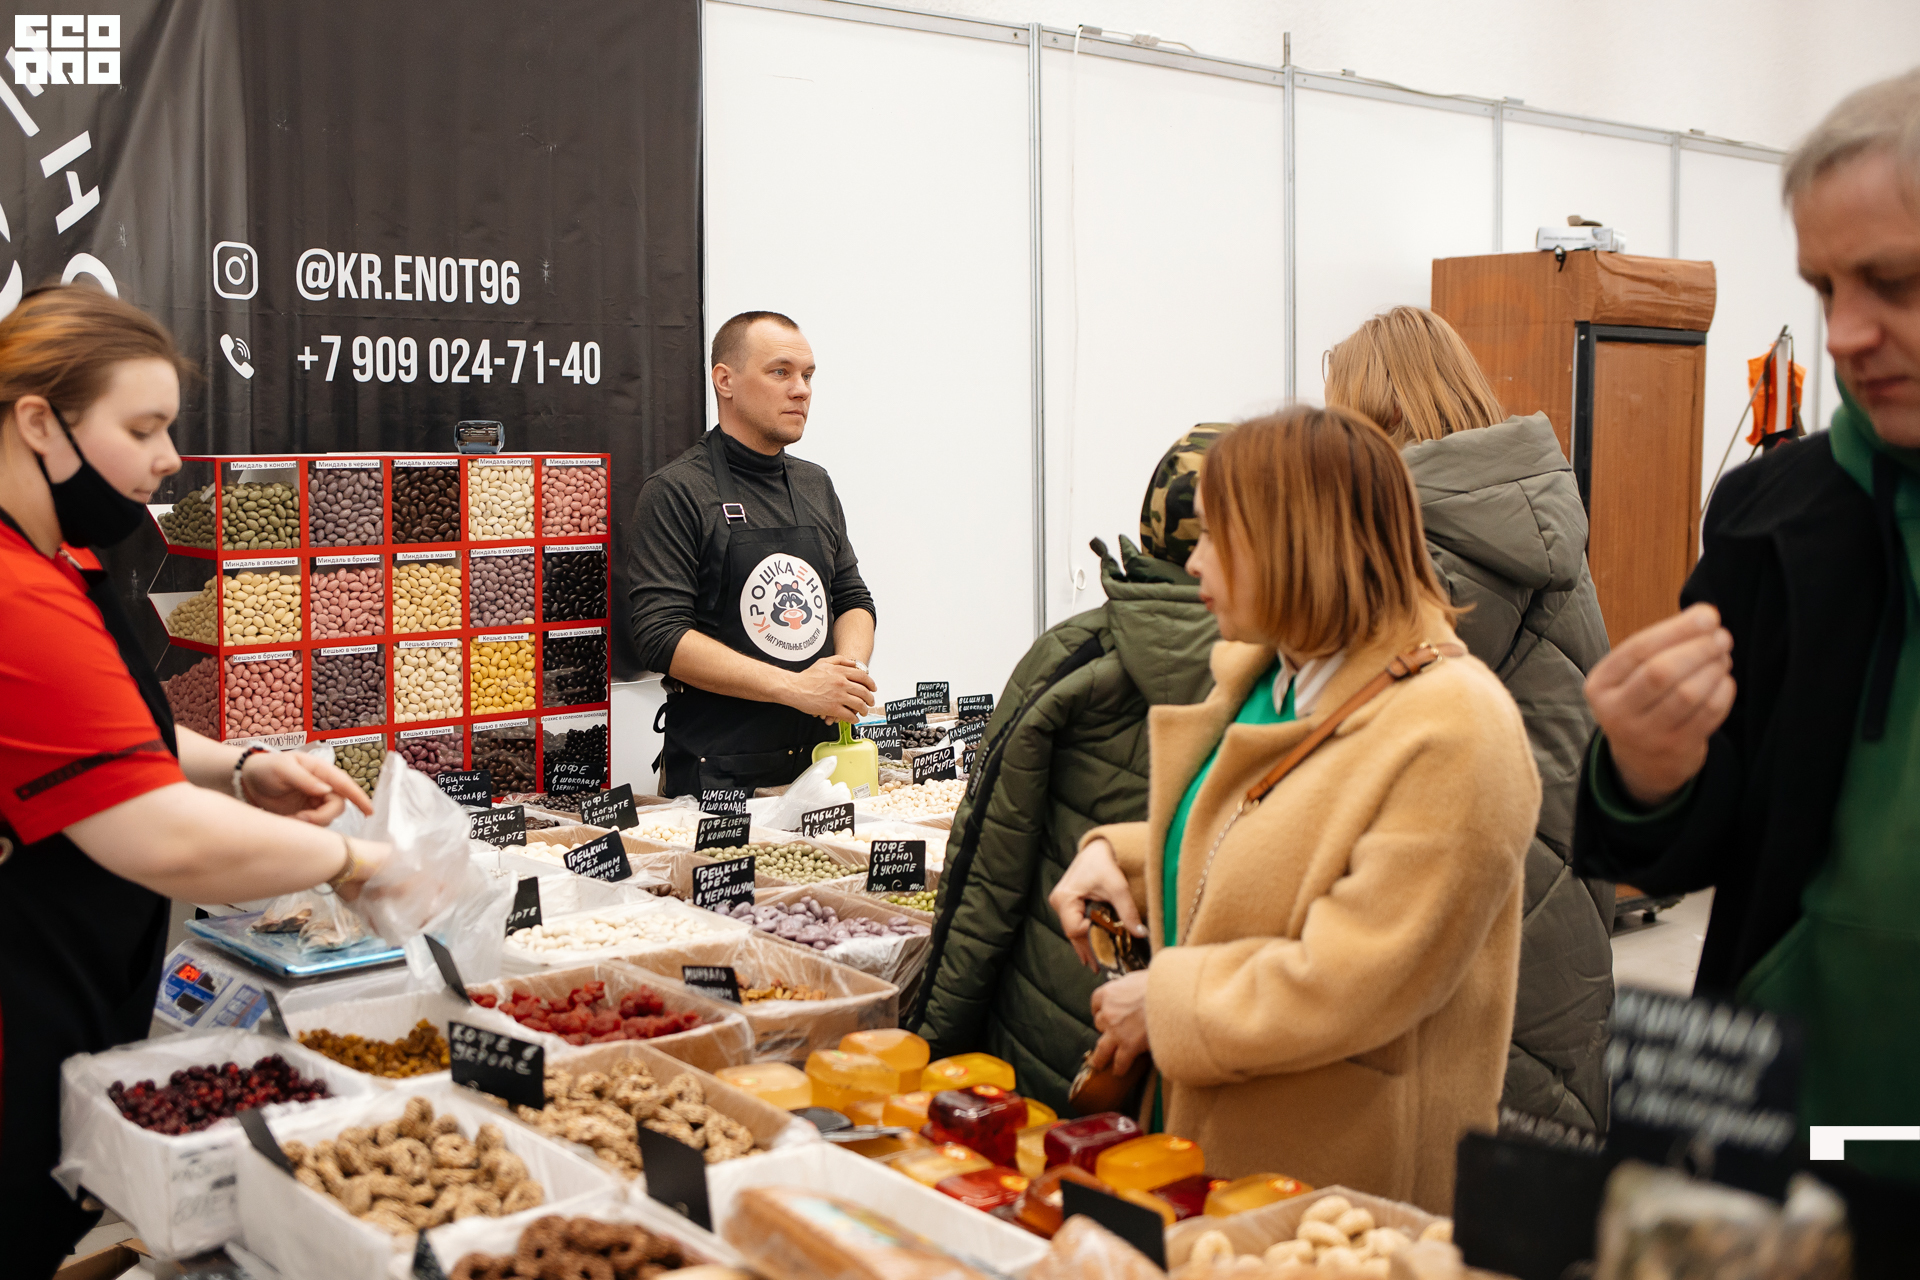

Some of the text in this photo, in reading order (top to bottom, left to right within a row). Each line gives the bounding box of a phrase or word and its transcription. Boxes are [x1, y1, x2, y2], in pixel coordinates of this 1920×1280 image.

[297, 248, 520, 304] @KR.ENOT96
[297, 335, 600, 385] +7 909 024-71-40
[318, 461, 347, 469] Миндаль
[480, 458, 505, 466] Миндаль
[471, 549, 498, 557] Миндаль
[261, 559, 295, 567] апельсине
[765, 632, 804, 651] НАТУРАЛЬНЫЕ
[263, 651, 293, 659] бруснике
[860, 726, 898, 740] КЛЮКВА
[876, 739, 900, 749] НОПЛЕ
[914, 749, 951, 768] ПОМЕЛО
[553, 763, 589, 774] КОФЕ
[581, 792, 610, 810] КОФЕ
[702, 789, 745, 801] ИМБИРЬ
[804, 806, 846, 823] ИМБИРЬ
[470, 824, 499, 838] ОРЕХ
[873, 841, 906, 853] КОФЕ
[574, 856, 598, 873] ОРЕХ
[880, 863, 917, 876] УКРОПЕ
[700, 875, 731, 891] ОРЕХ
